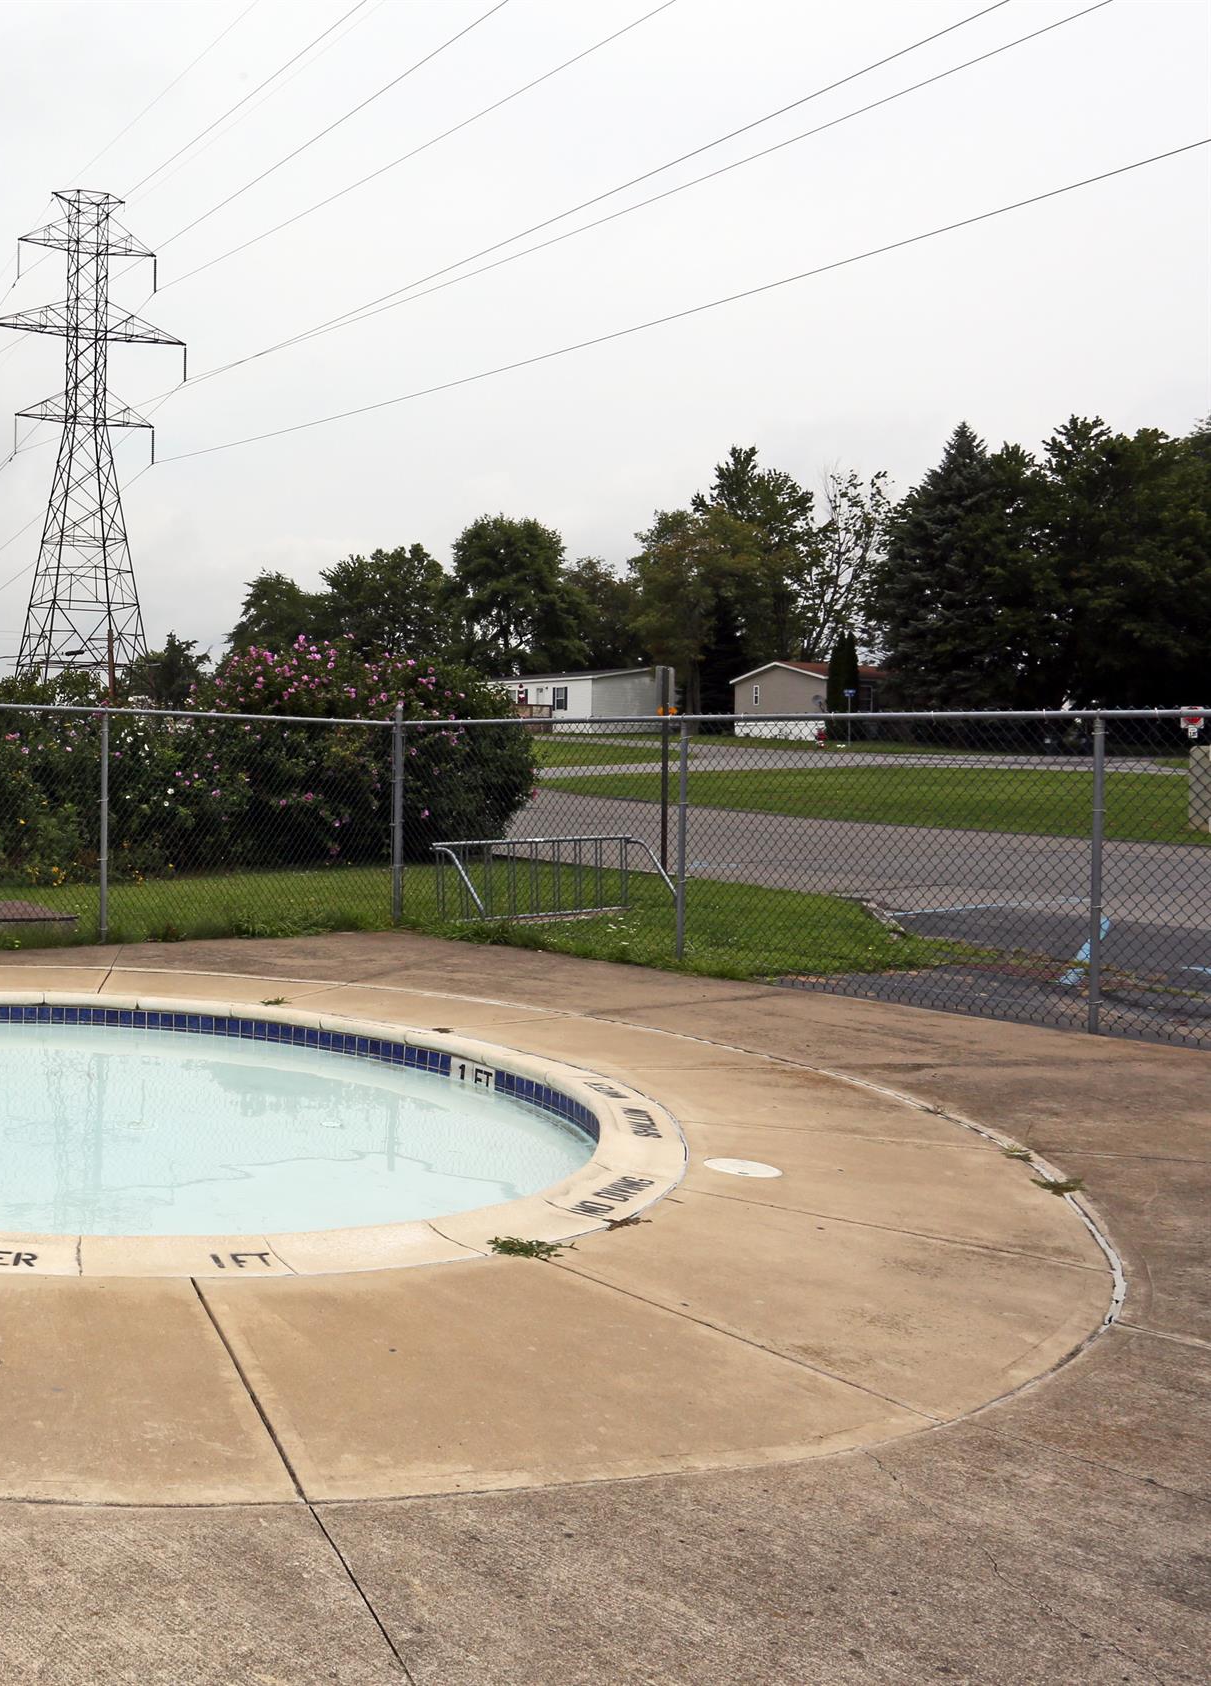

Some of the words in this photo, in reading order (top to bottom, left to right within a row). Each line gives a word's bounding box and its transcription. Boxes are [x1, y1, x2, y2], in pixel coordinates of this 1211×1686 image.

[459, 1064, 466, 1080] 1
[475, 1068, 493, 1087] FT
[592, 1176, 655, 1203] DIVING
[572, 1200, 615, 1217] NO
